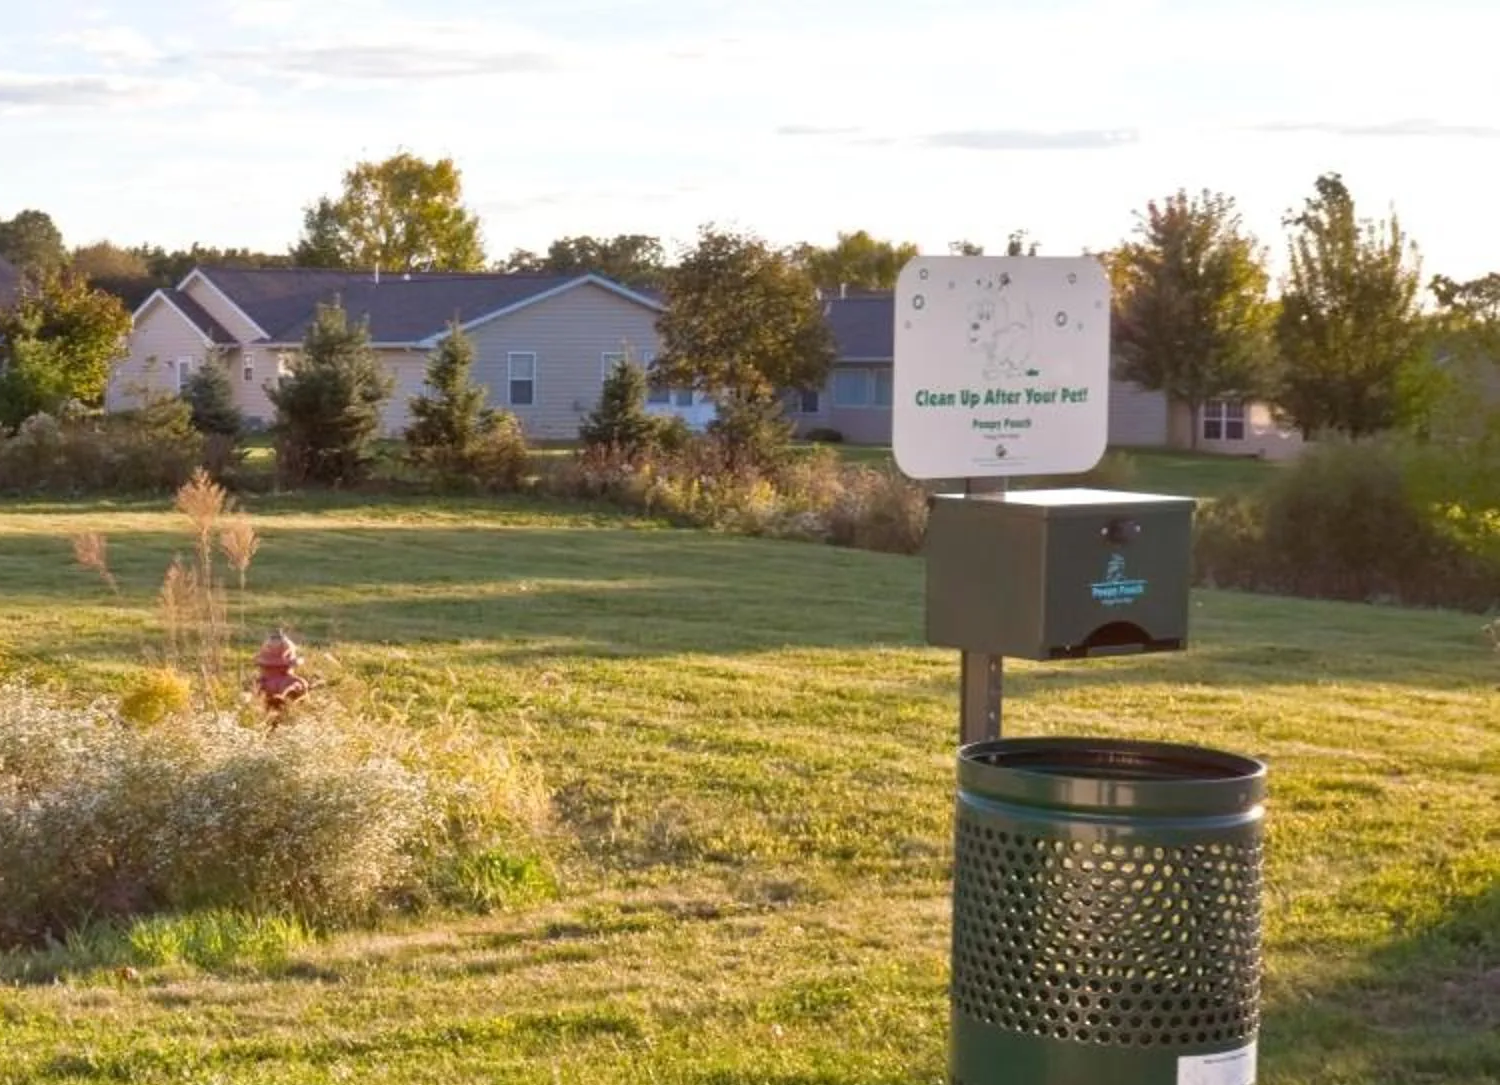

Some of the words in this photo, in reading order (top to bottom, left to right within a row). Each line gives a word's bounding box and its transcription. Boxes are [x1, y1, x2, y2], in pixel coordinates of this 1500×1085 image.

[915, 389, 956, 407] Clean
[960, 388, 981, 409] Up
[984, 387, 1021, 405] After
[1024, 387, 1056, 405] Your
[1061, 386, 1089, 404] Pet!
